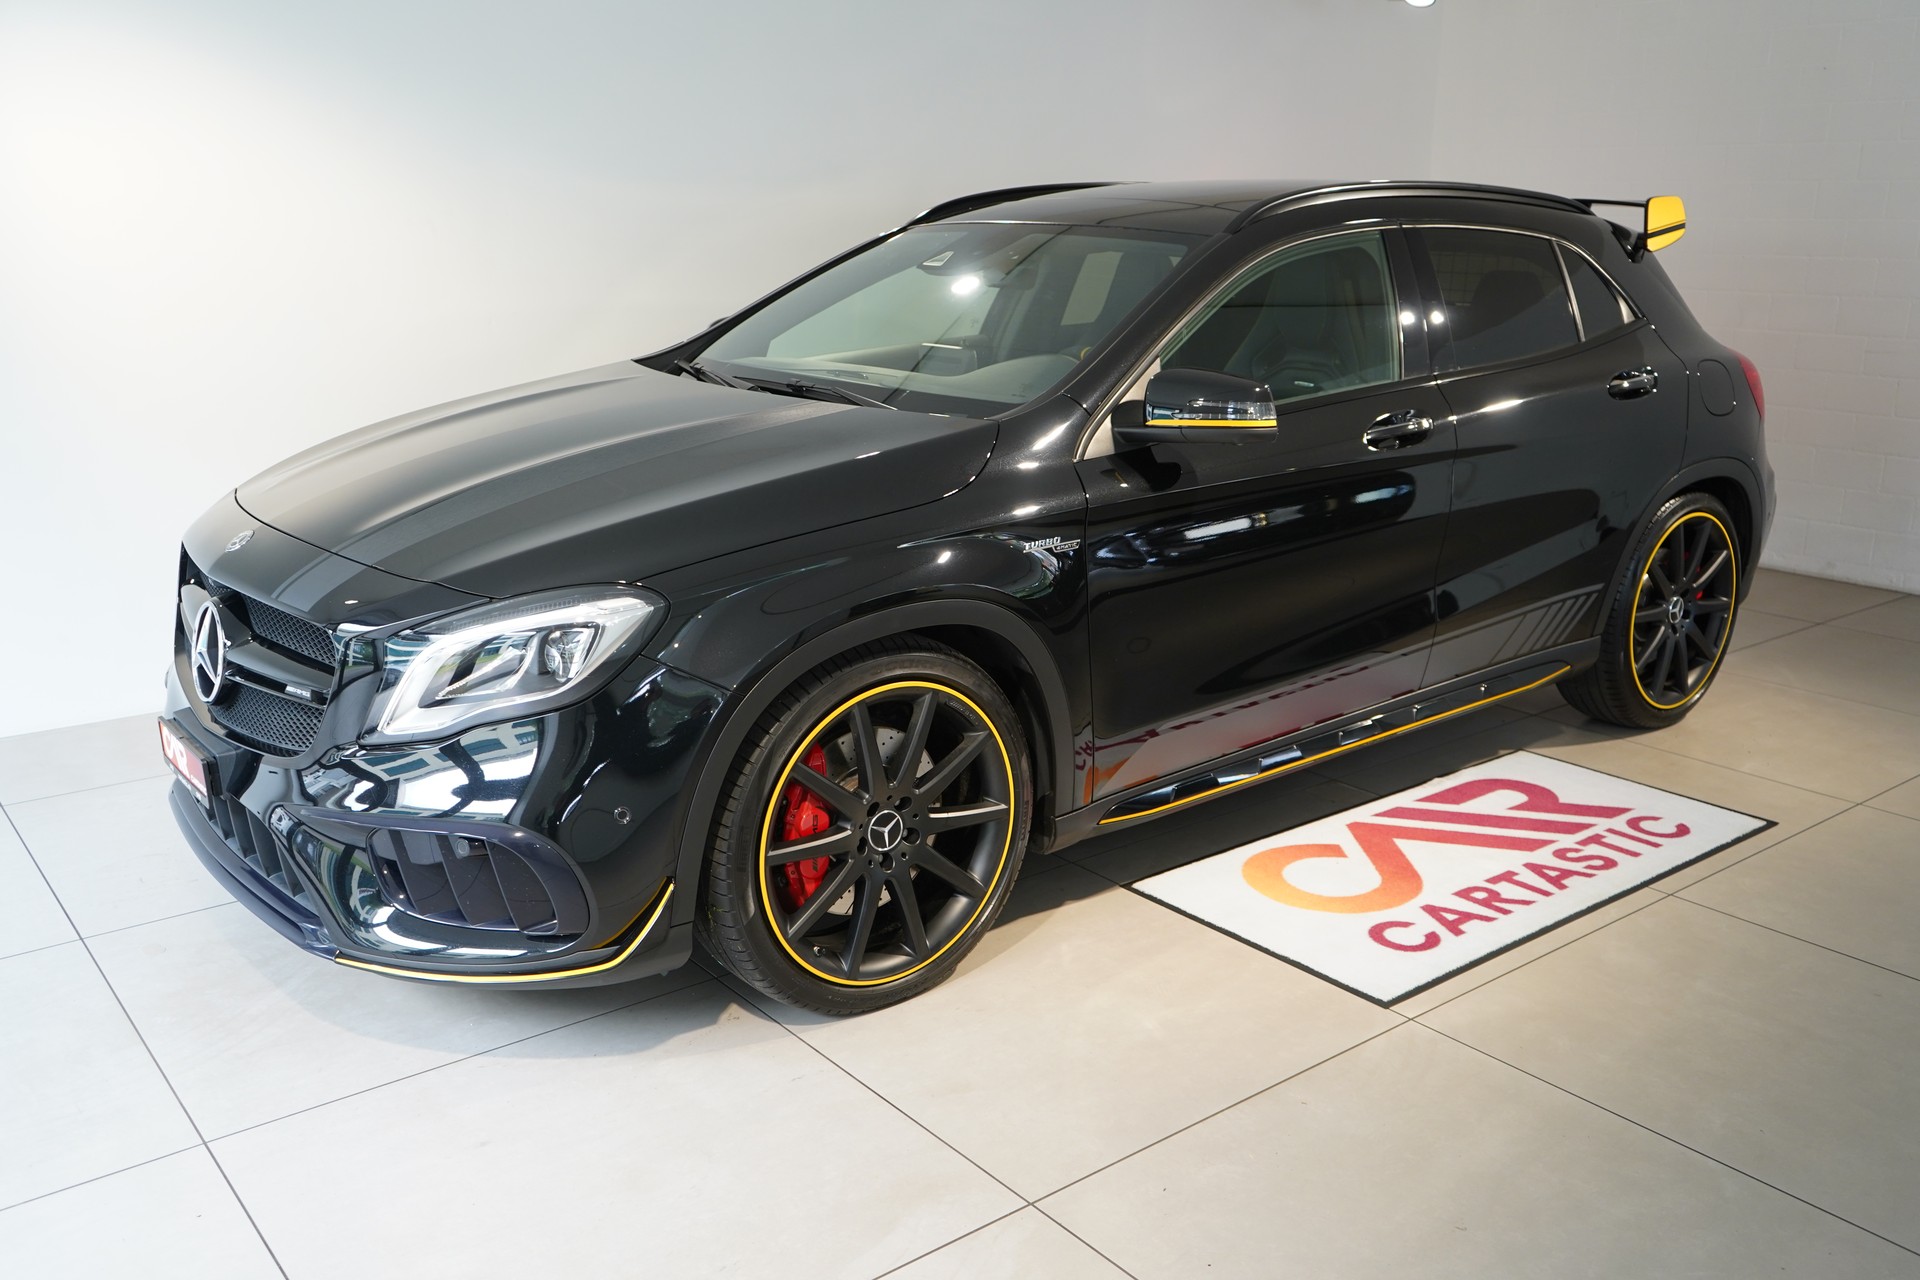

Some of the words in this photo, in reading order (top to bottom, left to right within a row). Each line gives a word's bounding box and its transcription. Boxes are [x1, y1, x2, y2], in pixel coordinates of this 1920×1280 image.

[1023, 536, 1062, 550] TURBO
[1055, 542, 1078, 551] 4MATIC
[1367, 815, 1692, 953] CARTASTIC
